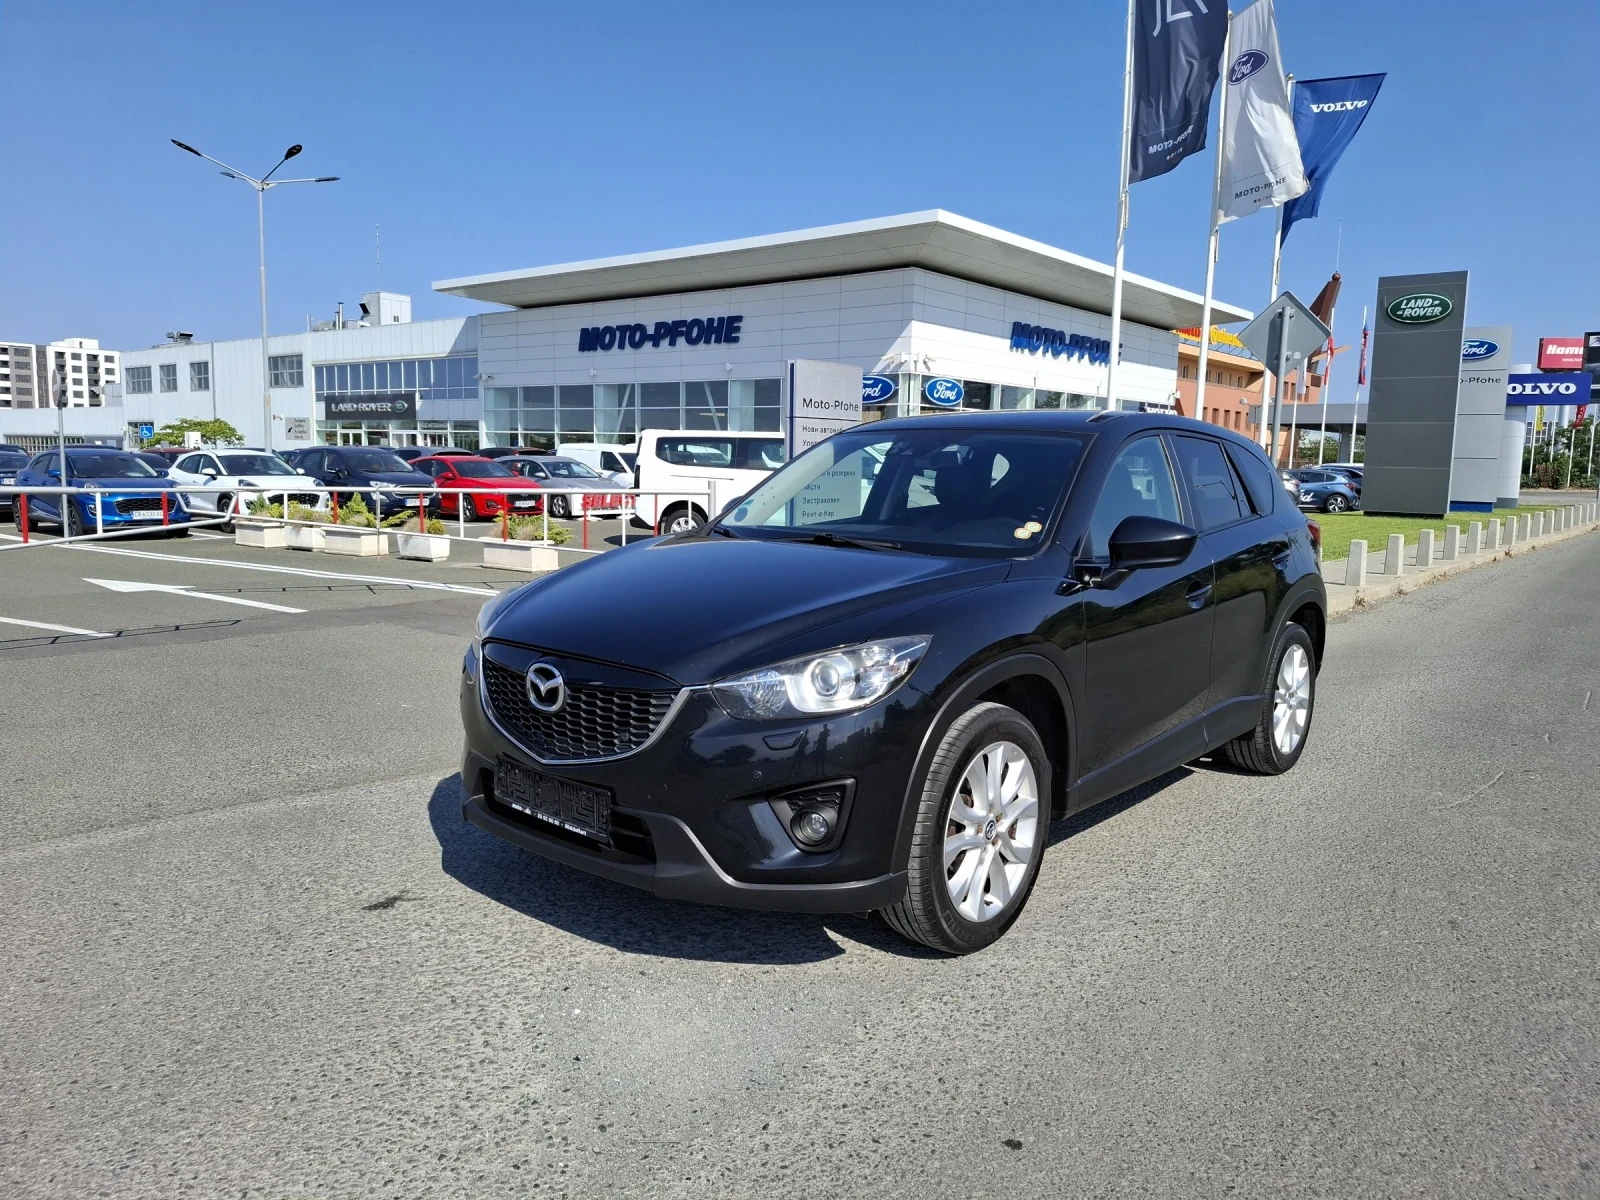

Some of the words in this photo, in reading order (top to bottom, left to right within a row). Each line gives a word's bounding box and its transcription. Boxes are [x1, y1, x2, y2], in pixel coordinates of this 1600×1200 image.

[1232, 55, 1254, 81] Ford
[1310, 100, 1368, 113] VOLVO
[1400, 298, 1433, 309] LAND
[1402, 306, 1443, 318] ROVER
[578, 315, 743, 352] MOTO-PFOHE
[933, 381, 957, 400] Ford
[331, 402, 357, 412] LAND
[358, 402, 392, 412] ROVER
[802, 397, 859, 412] Moto-Pfohe
[802, 424, 819, 433] Нови
[802, 497, 840, 505] Застраховки
[802, 510, 835, 518] Рент-а-Кар
